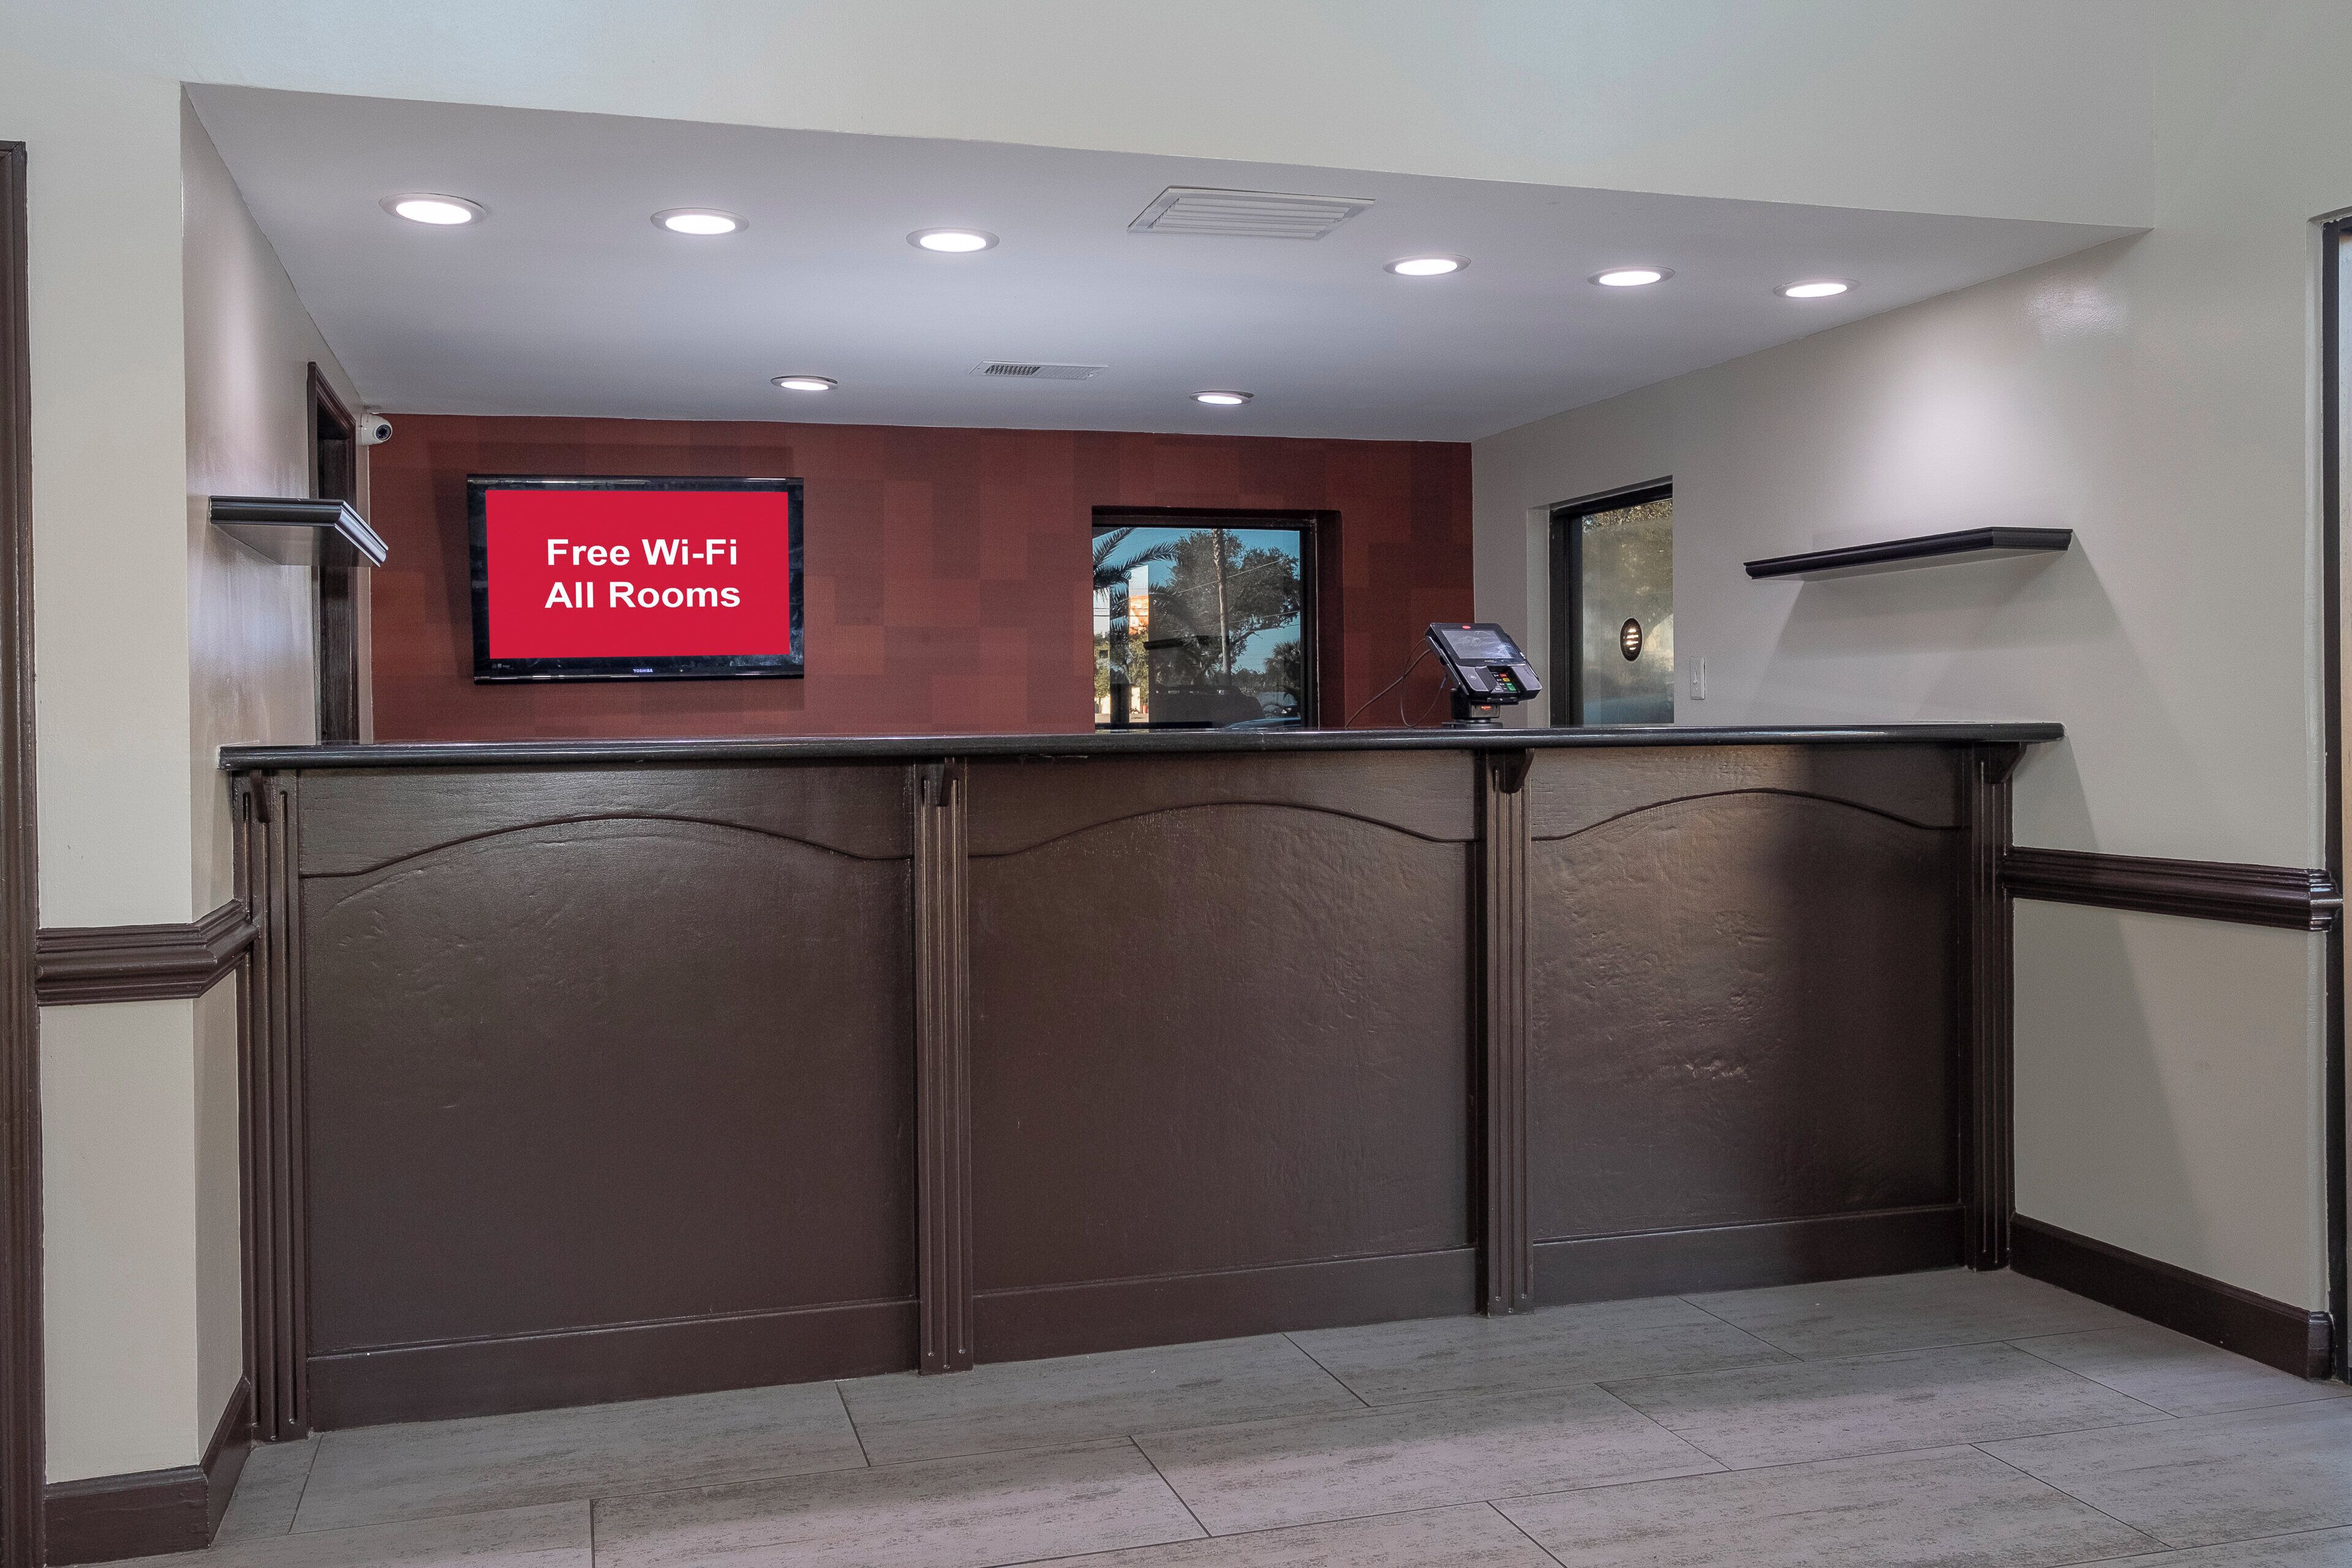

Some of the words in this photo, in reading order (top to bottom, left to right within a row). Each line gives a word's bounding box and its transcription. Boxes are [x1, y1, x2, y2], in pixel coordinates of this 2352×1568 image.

[548, 539, 630, 565] Free
[641, 539, 737, 565] Wi-Fi
[545, 582, 594, 608] All
[609, 582, 741, 608] Rooms
